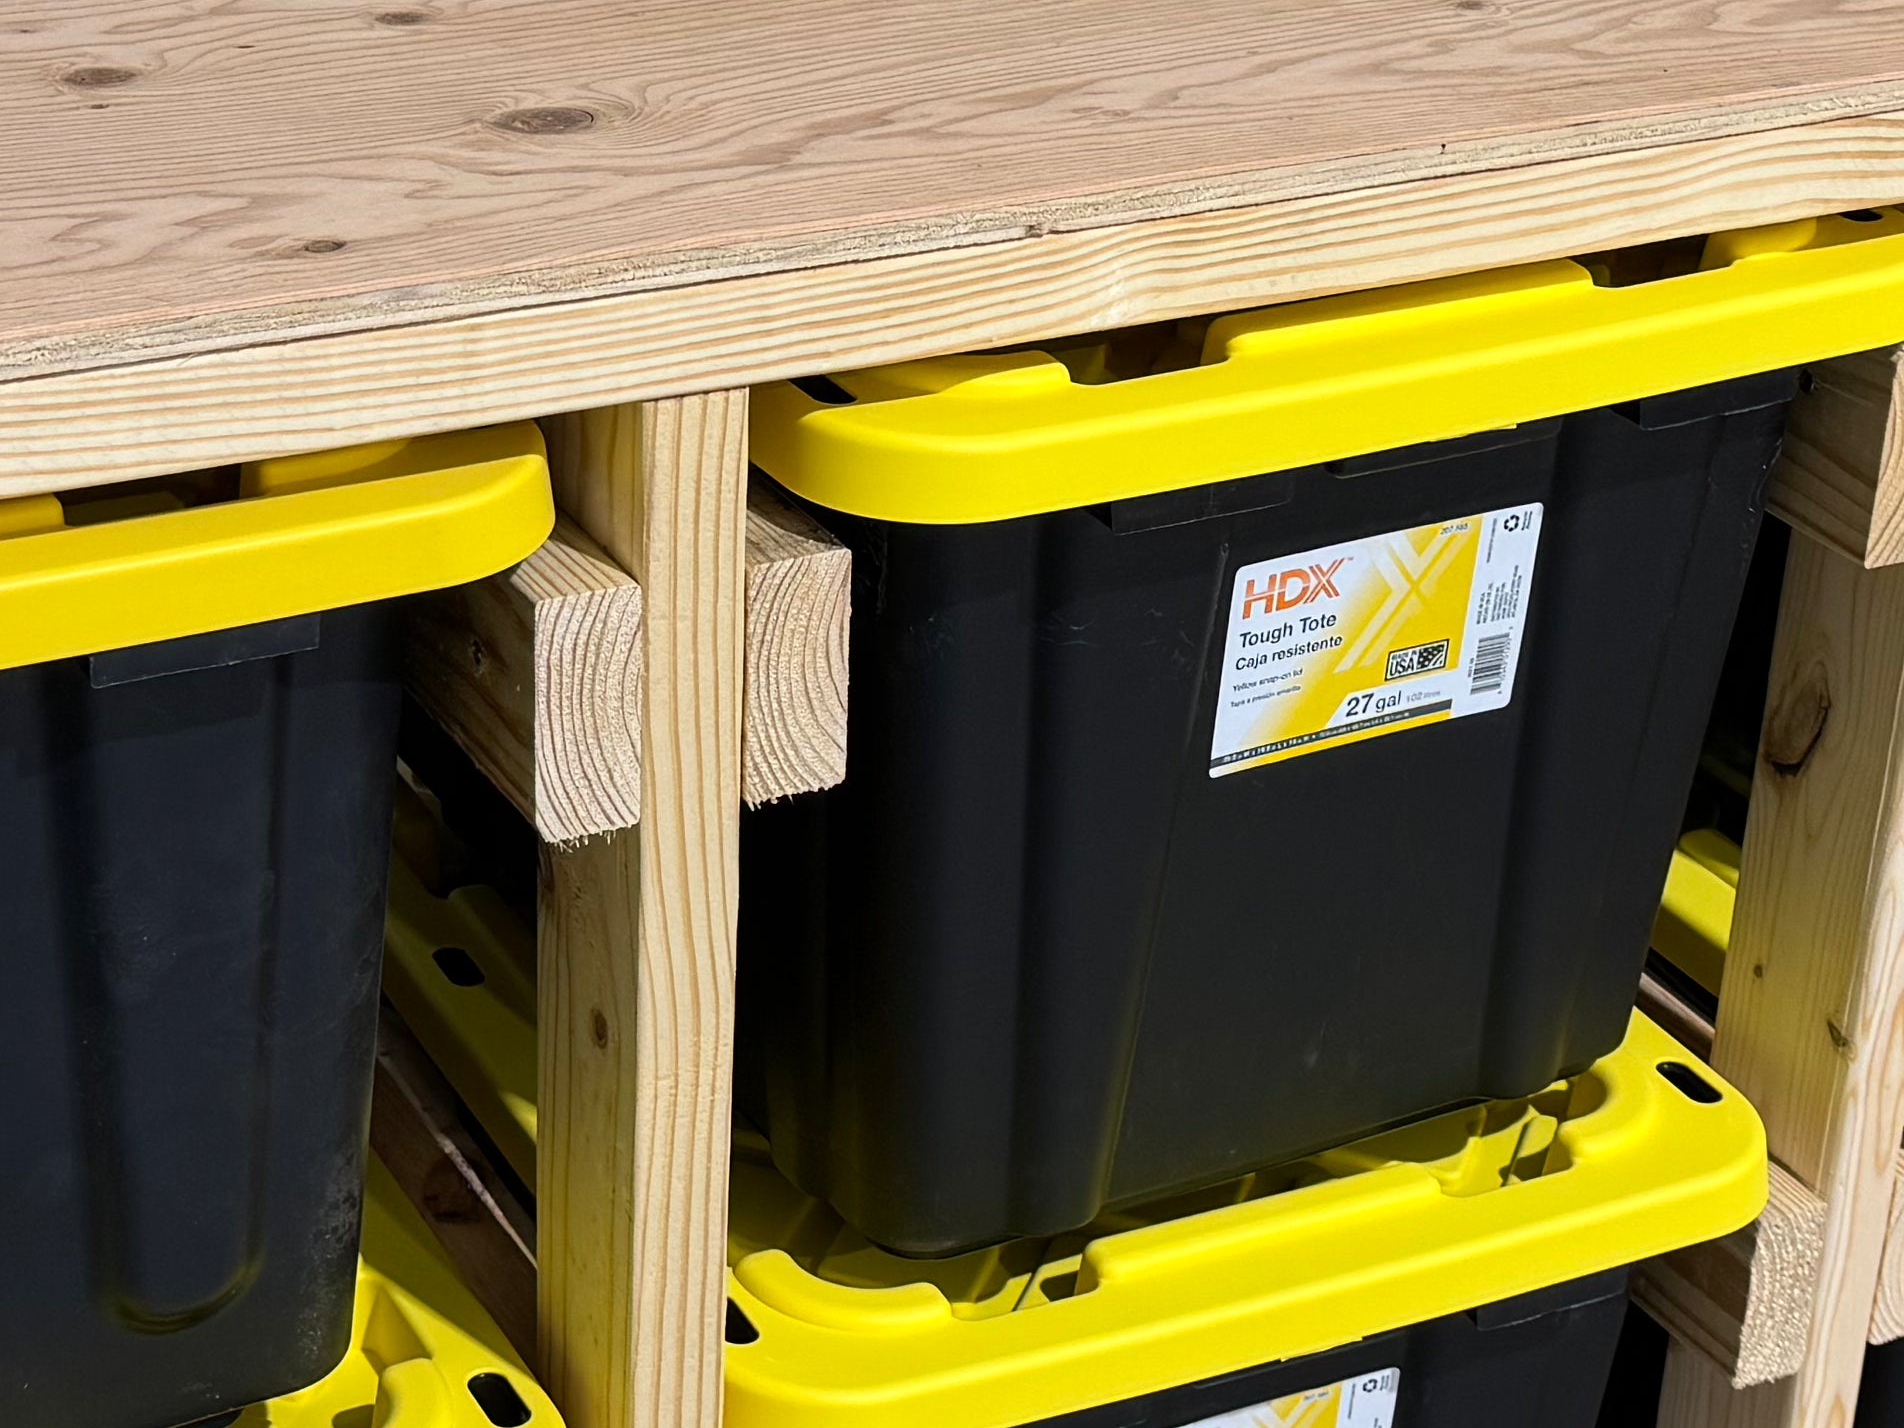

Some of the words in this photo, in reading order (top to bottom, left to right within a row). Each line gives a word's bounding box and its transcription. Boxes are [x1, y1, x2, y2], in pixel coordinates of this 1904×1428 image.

[1241, 557, 1345, 619] HDX
[1239, 622, 1293, 648] Tough
[1299, 613, 1336, 633] Tote
[1235, 653, 1267, 670] Caja
[1271, 635, 1342, 661] resistente
[1389, 656, 1414, 676] USA
[1345, 693, 1373, 717] 27
[1375, 690, 1401, 713] gal
